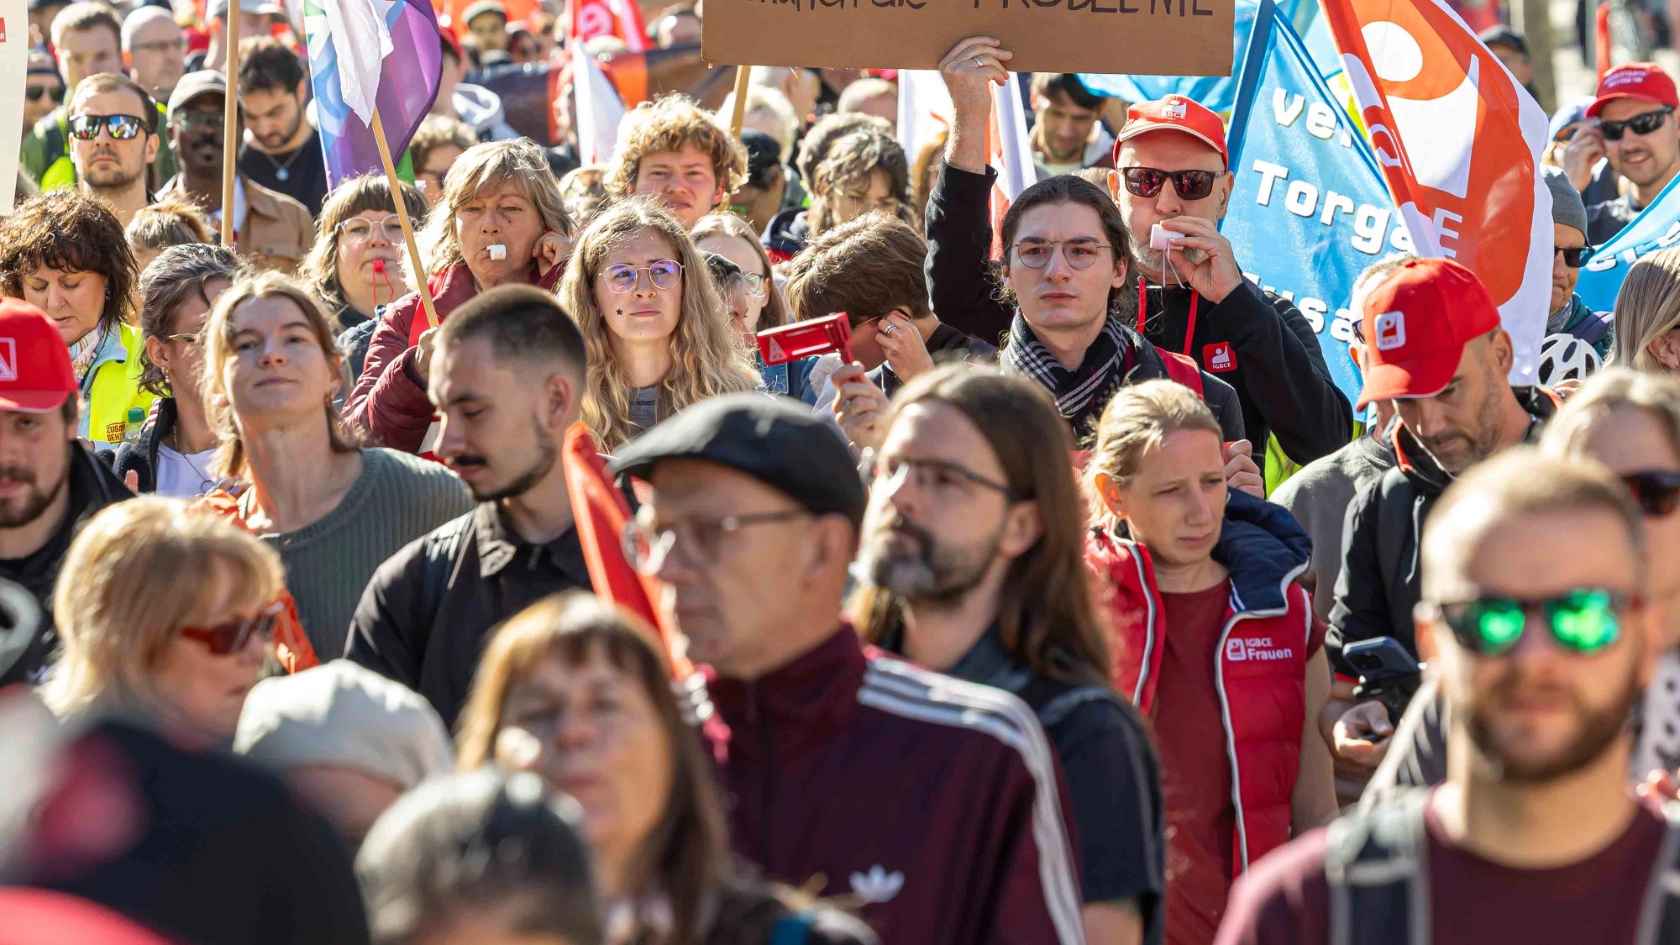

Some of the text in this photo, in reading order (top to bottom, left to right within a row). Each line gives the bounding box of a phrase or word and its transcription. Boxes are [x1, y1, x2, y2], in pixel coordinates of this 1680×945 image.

[1212, 361, 1232, 369] IGBCE
[1245, 637, 1273, 647] IGBCE
[1248, 647, 1292, 660] Frauen
